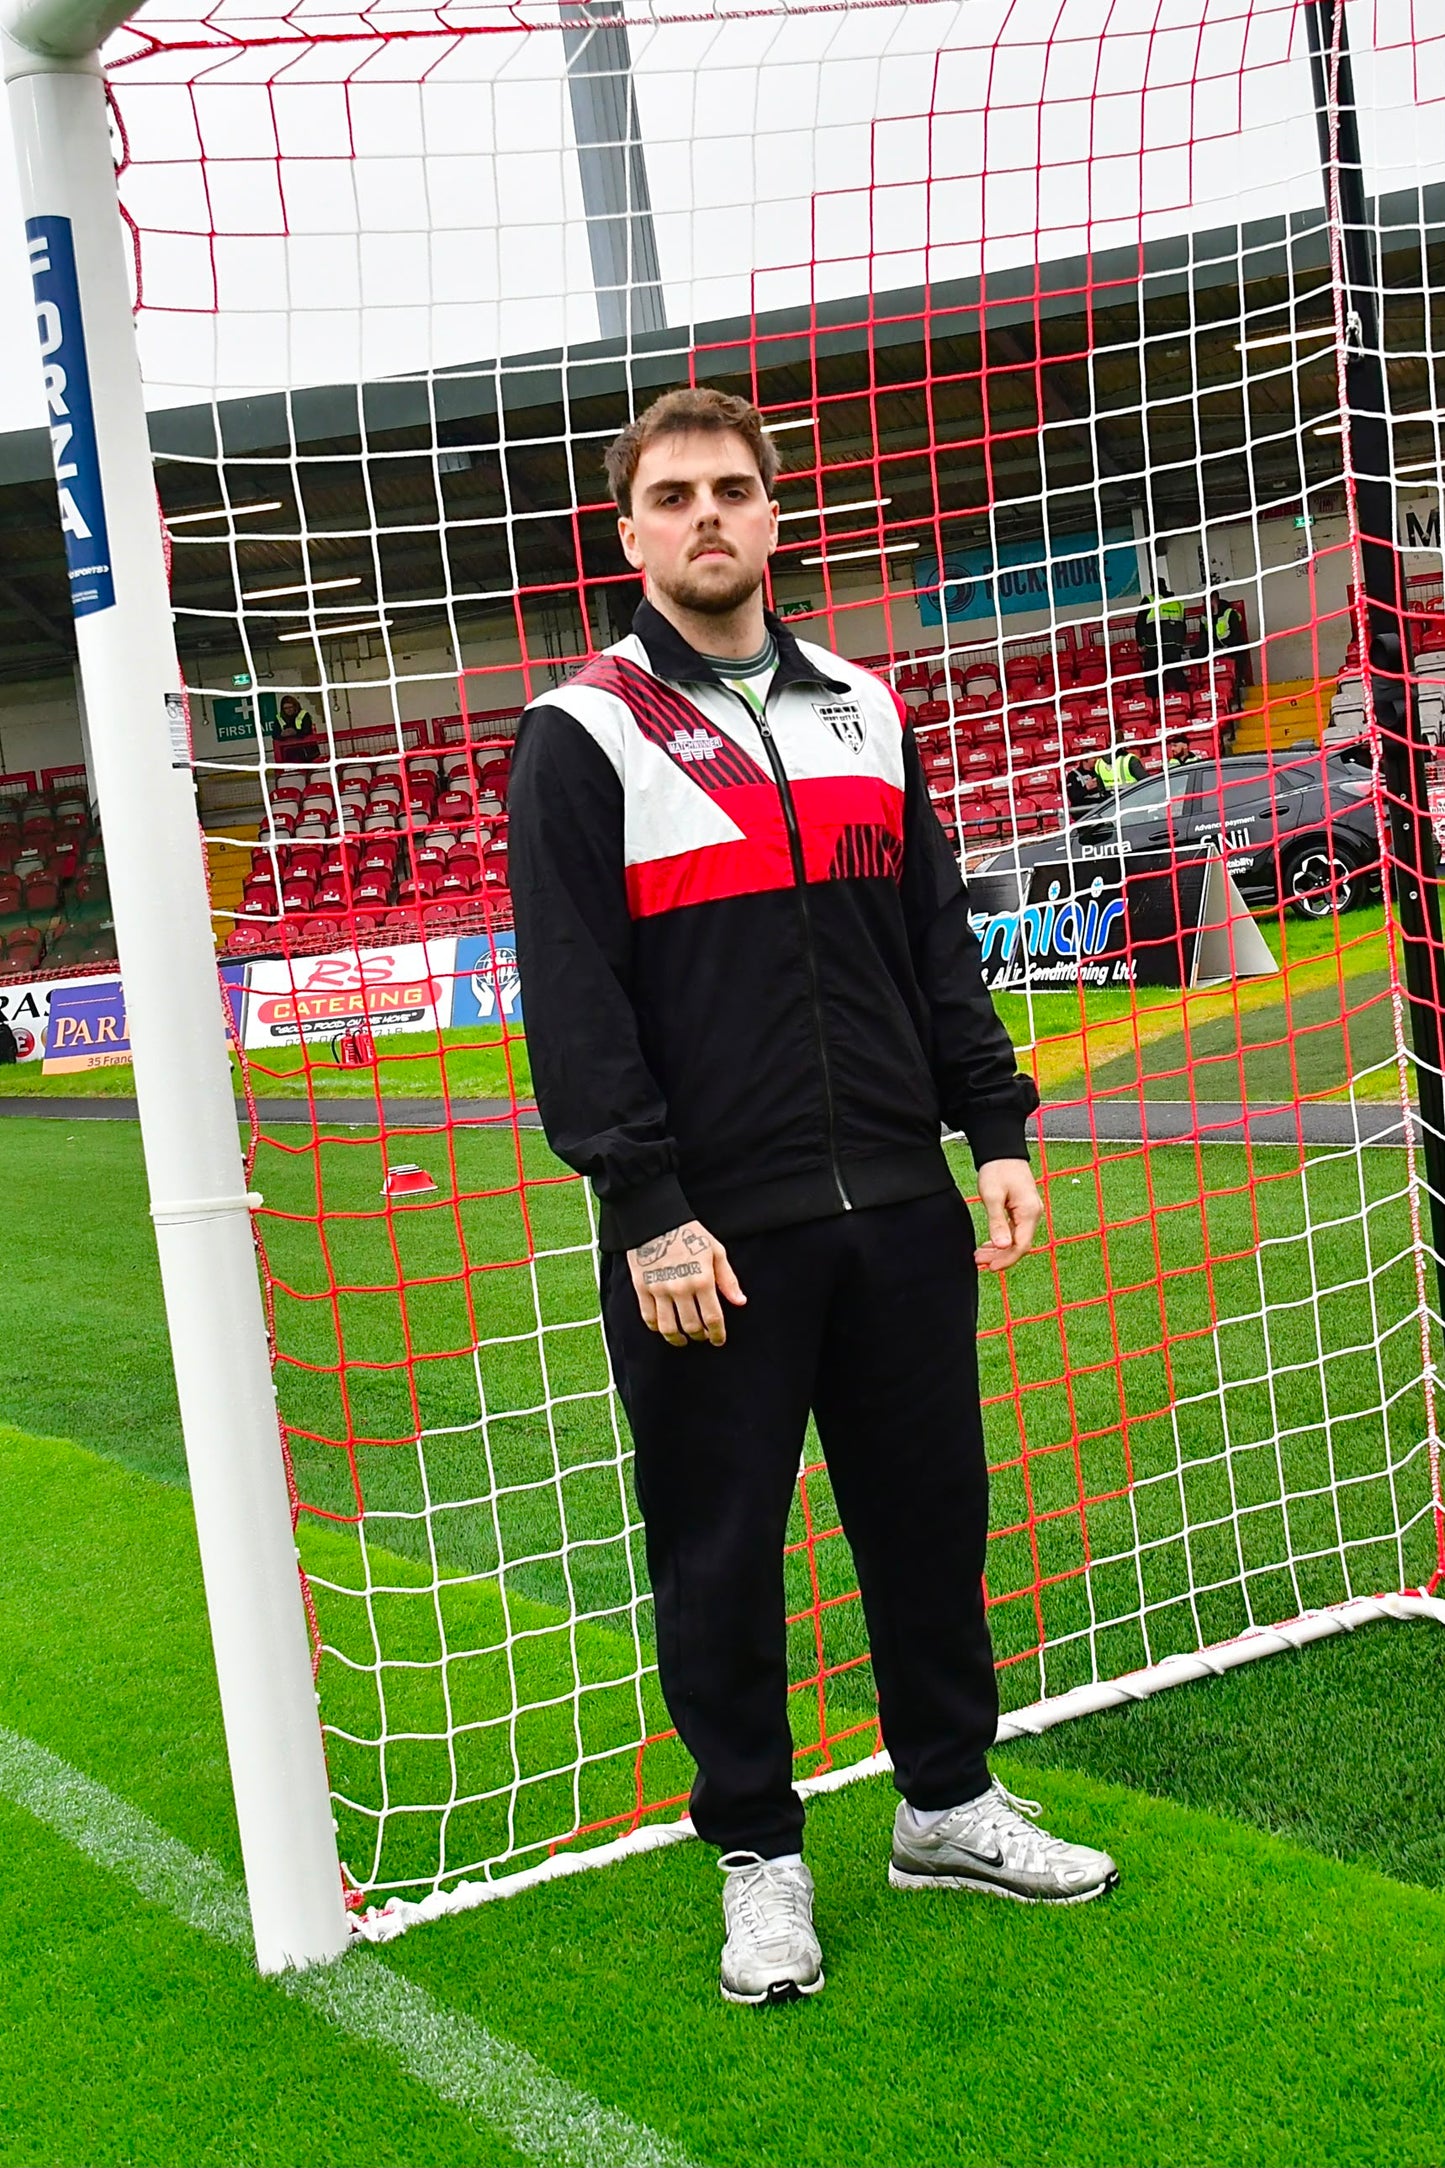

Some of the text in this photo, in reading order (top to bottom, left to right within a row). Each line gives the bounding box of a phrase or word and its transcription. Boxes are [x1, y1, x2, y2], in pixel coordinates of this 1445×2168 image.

[28, 236, 92, 540] FORZA
[218, 724, 252, 738] FIRST
[1194, 815, 1256, 832] Advanc payment
[1081, 840, 1132, 859] Puma
[304, 955, 396, 989] RS
[1027, 960, 1109, 985] Conditioning
[273, 988, 423, 1018] CATERING
[313, 1020, 345, 1032] FOOD
[88, 1058, 101, 1068] 35
[643, 1260, 702, 1285] ERROR
